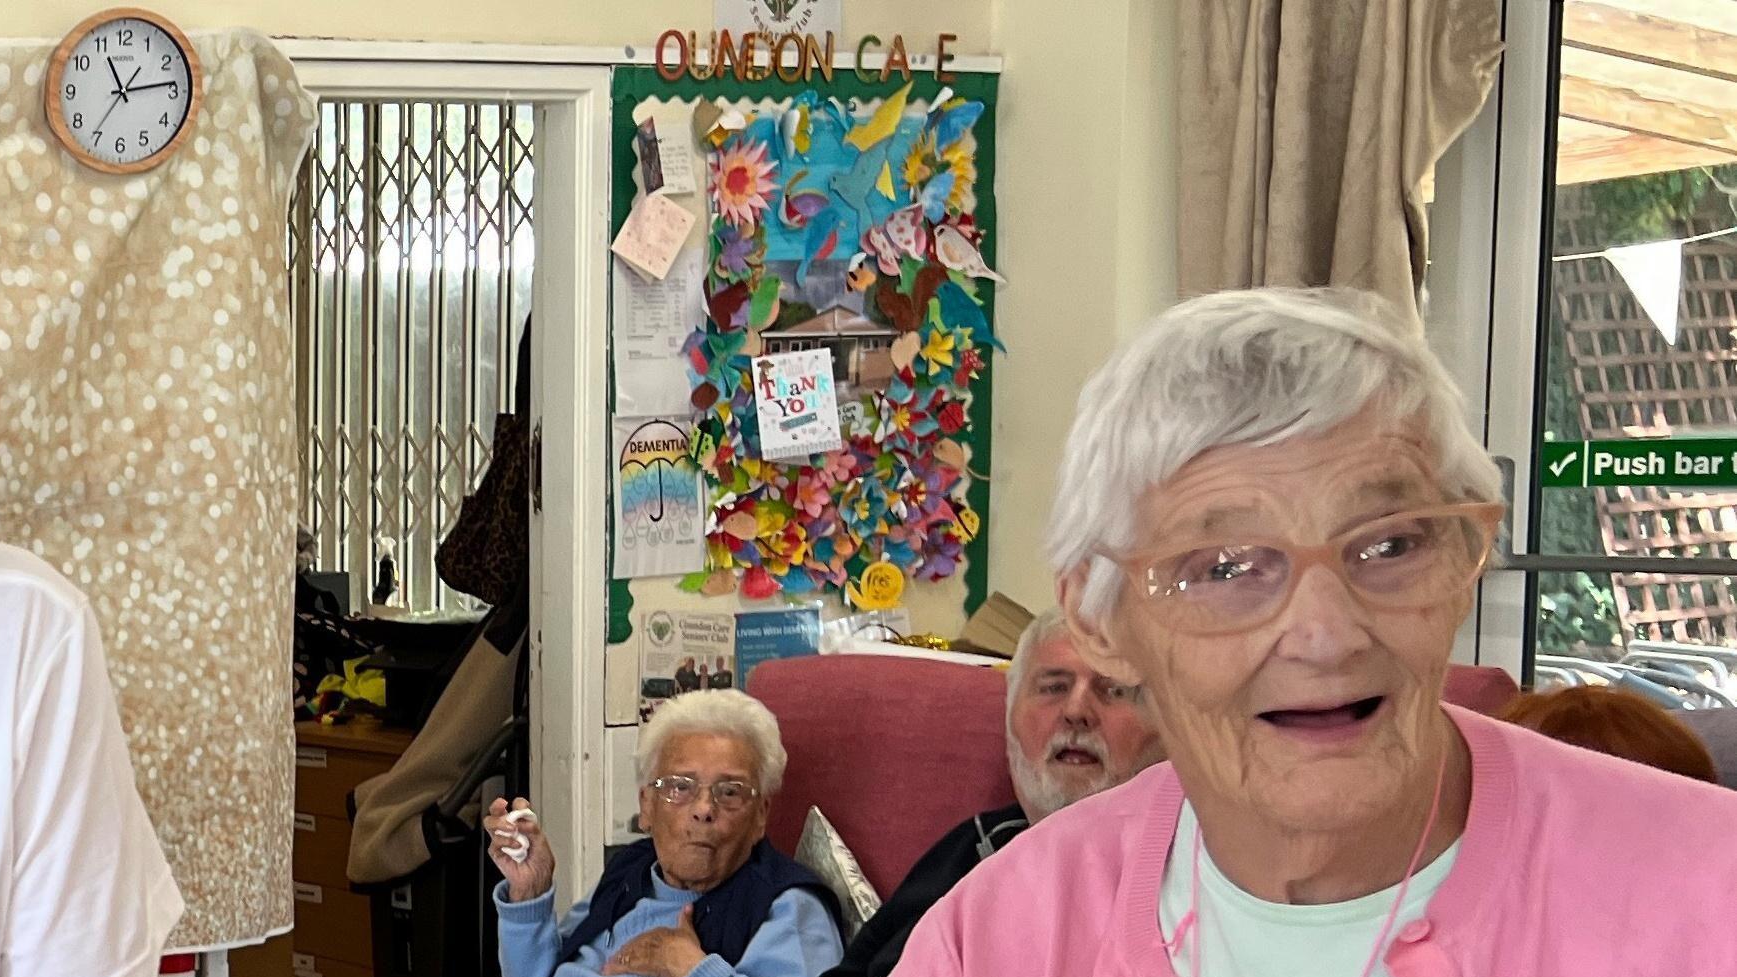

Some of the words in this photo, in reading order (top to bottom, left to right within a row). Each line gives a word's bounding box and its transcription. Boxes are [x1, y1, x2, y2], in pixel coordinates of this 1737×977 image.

[94, 36, 107, 53] 11
[116, 29, 133, 46] 12
[144, 36, 150, 53] 1
[73, 55, 90, 71] 10
[161, 54, 172, 71] 2
[65, 83, 76, 100] 9
[167, 82, 178, 100] 3
[72, 112, 83, 129] 8
[158, 112, 169, 128] 4
[92, 130, 103, 147] 7
[114, 137, 126, 154] 6
[138, 130, 149, 147] 5
[629, 438, 689, 454] DEMENTIA
[1594, 451, 1666, 476] Push
[1674, 451, 1724, 475] bar
